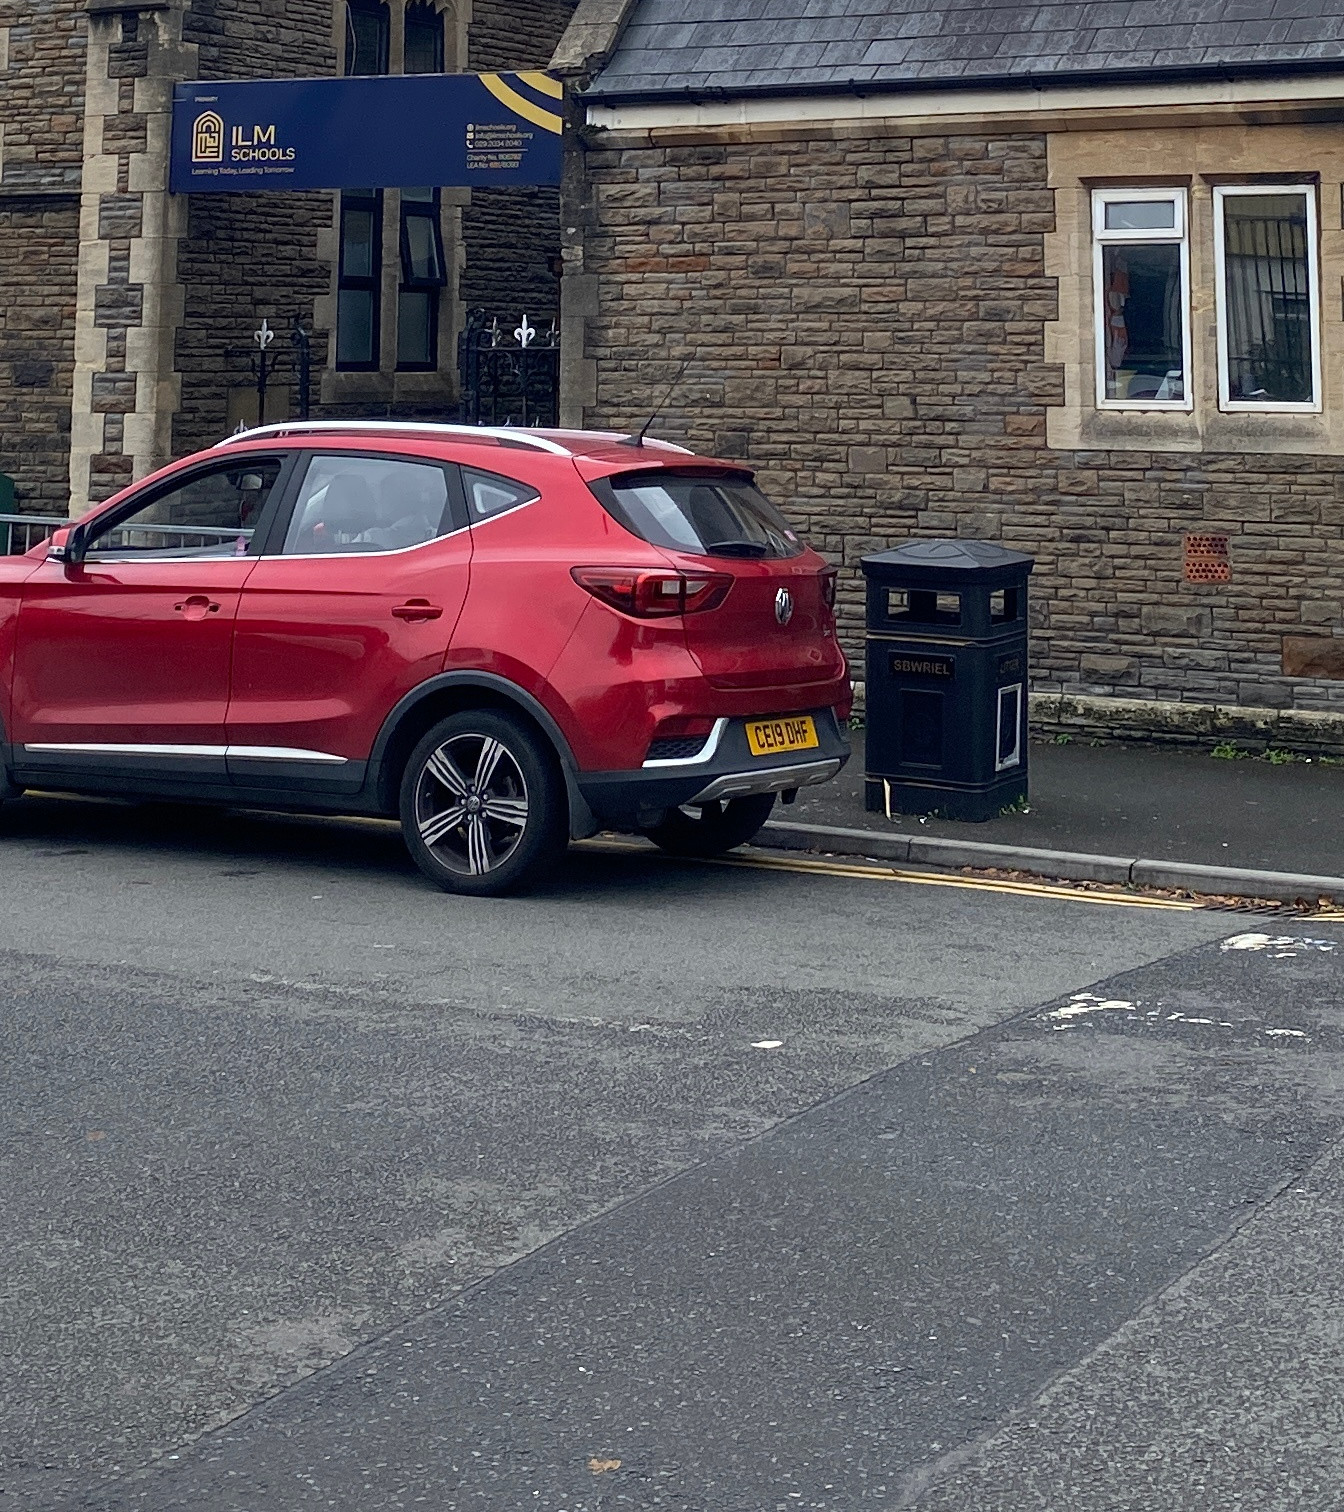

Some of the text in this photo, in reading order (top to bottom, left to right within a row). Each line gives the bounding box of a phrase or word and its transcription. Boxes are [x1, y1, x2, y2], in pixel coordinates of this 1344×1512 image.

[231, 124, 276, 146] ILM
[231, 147, 296, 161] SCHOOLS
[192, 168, 219, 176] Learning
[263, 166, 295, 174] Tomorrow
[893, 659, 951, 676] SBWRIEL
[754, 719, 808, 748] CE19 DHF
